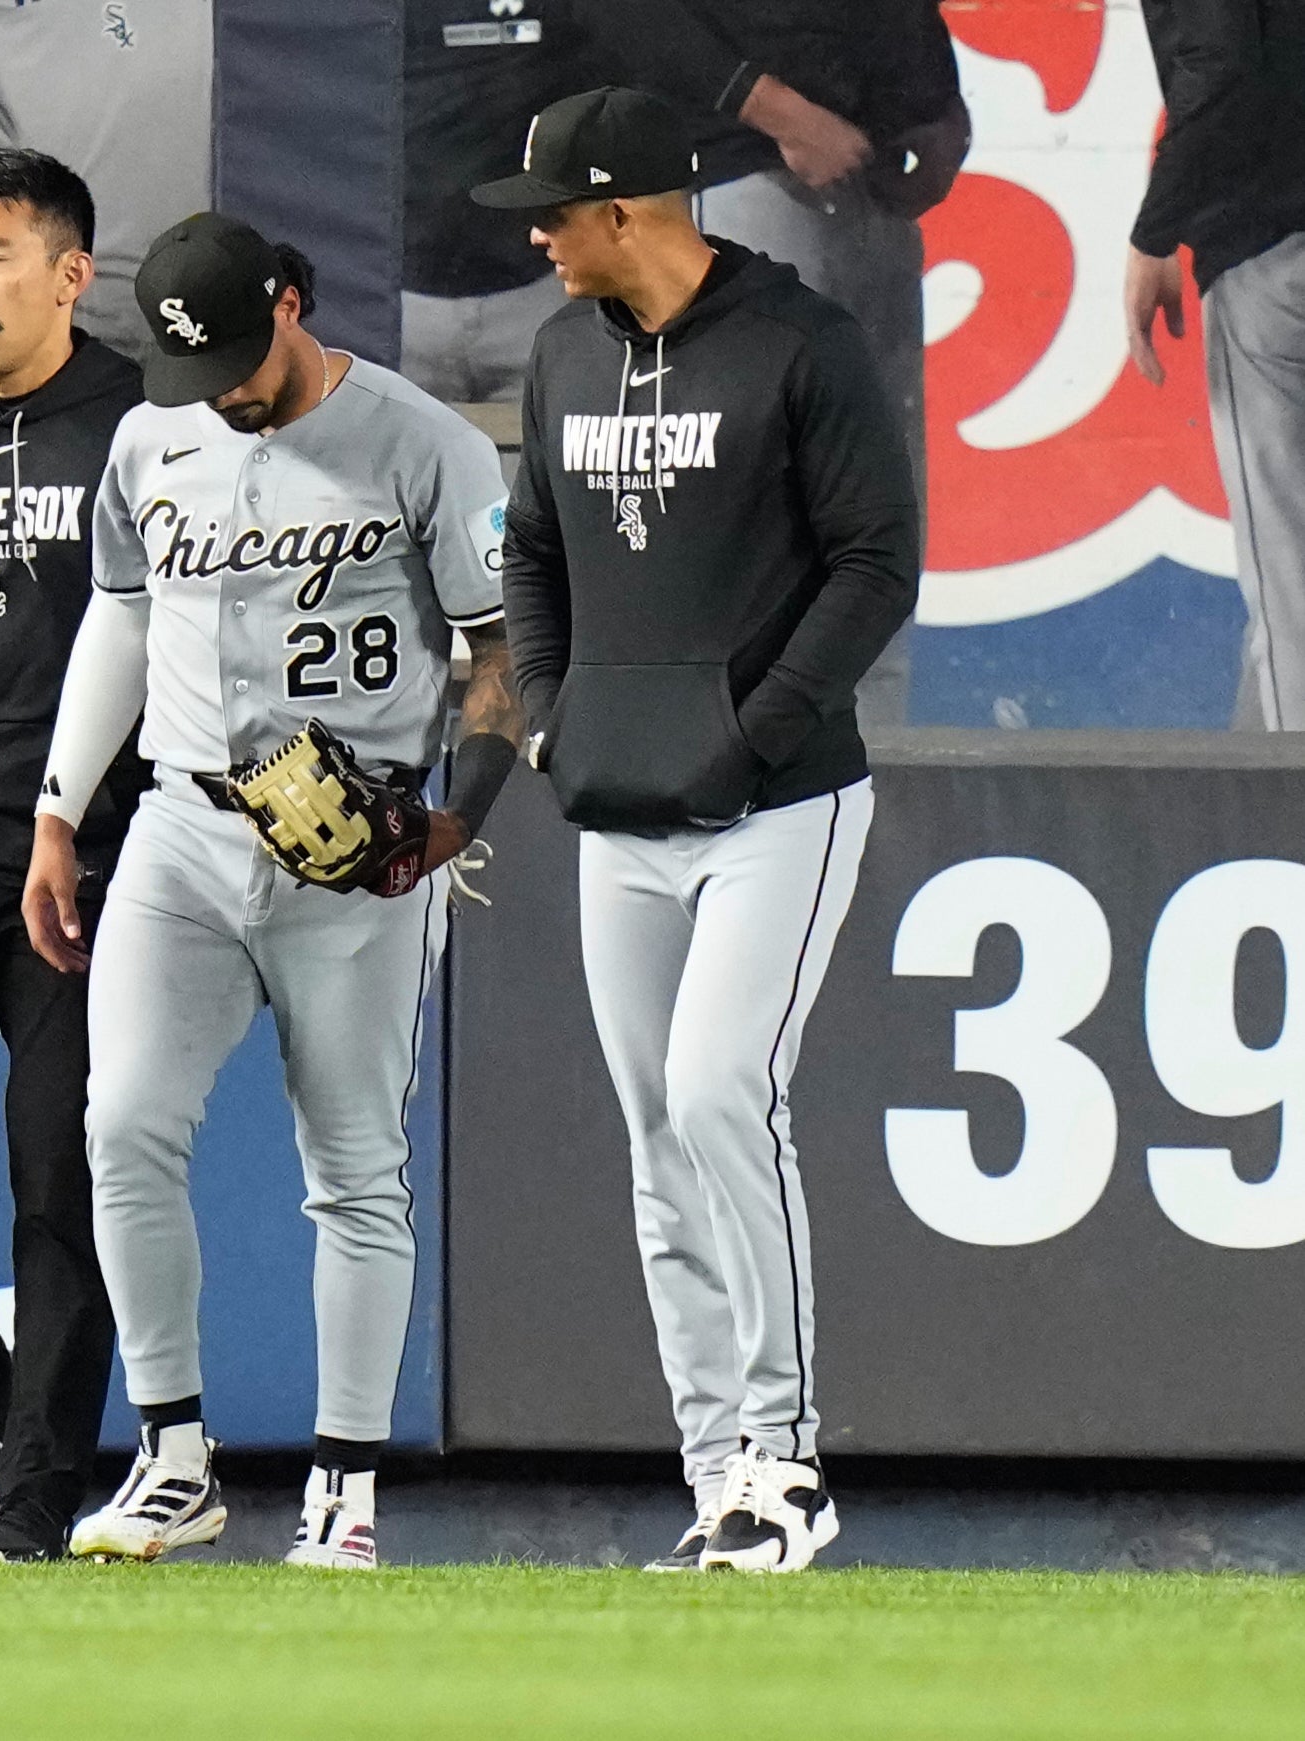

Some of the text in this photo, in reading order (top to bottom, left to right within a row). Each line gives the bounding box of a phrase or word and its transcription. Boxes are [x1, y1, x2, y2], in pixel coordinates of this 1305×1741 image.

[159, 298, 208, 346] Sox
[562, 412, 723, 472] WHITE SOX
[13, 486, 85, 541] SOX
[134, 498, 403, 613] Chicago
[282, 610, 400, 701] 28
[885, 856, 1305, 1250] 39
